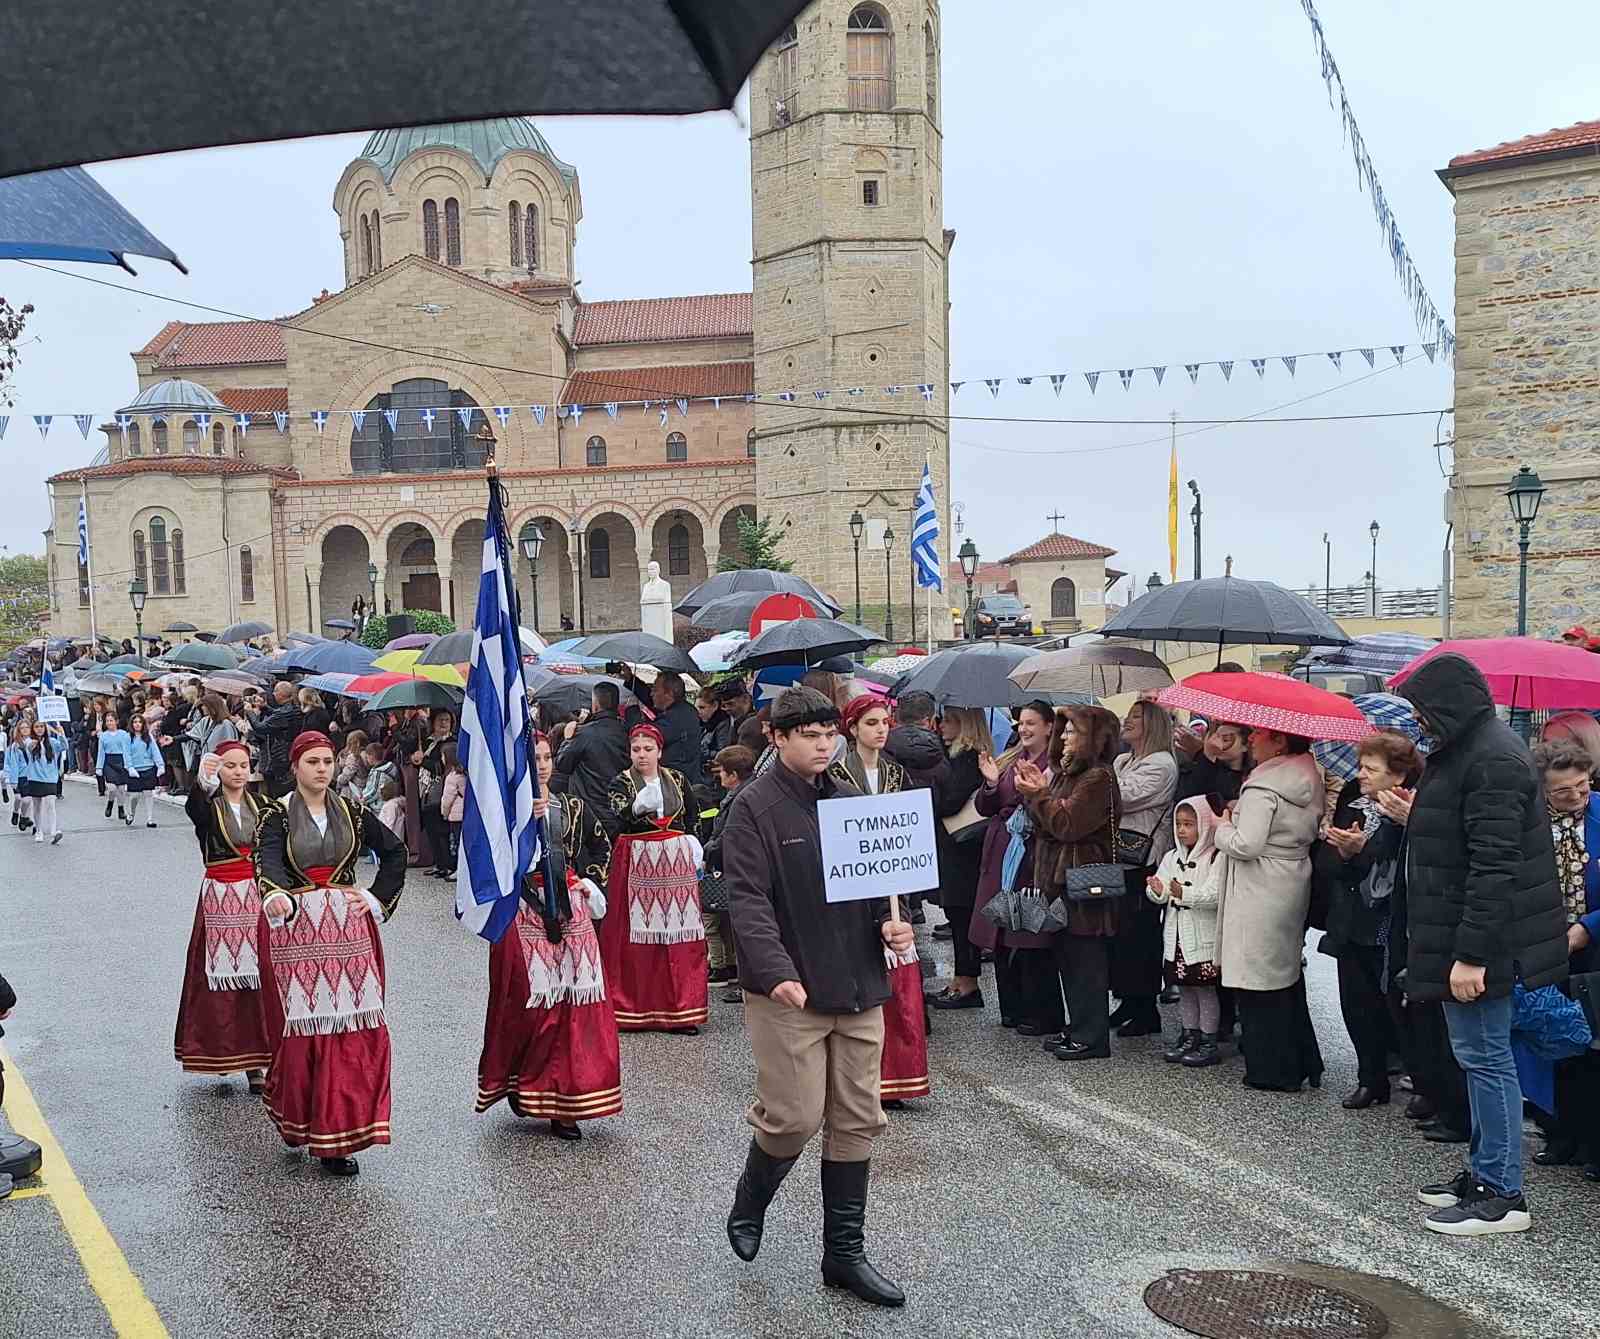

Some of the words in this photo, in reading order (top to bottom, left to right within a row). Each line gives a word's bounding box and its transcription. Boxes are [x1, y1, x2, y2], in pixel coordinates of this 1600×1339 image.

[844, 812, 919, 833] ΓΥΜΝΑΣΙΟ
[859, 834, 912, 854] ΒΑΜΟΥ
[829, 853, 934, 879] ΑΠΟΚΟΡΩΝΟΥ
